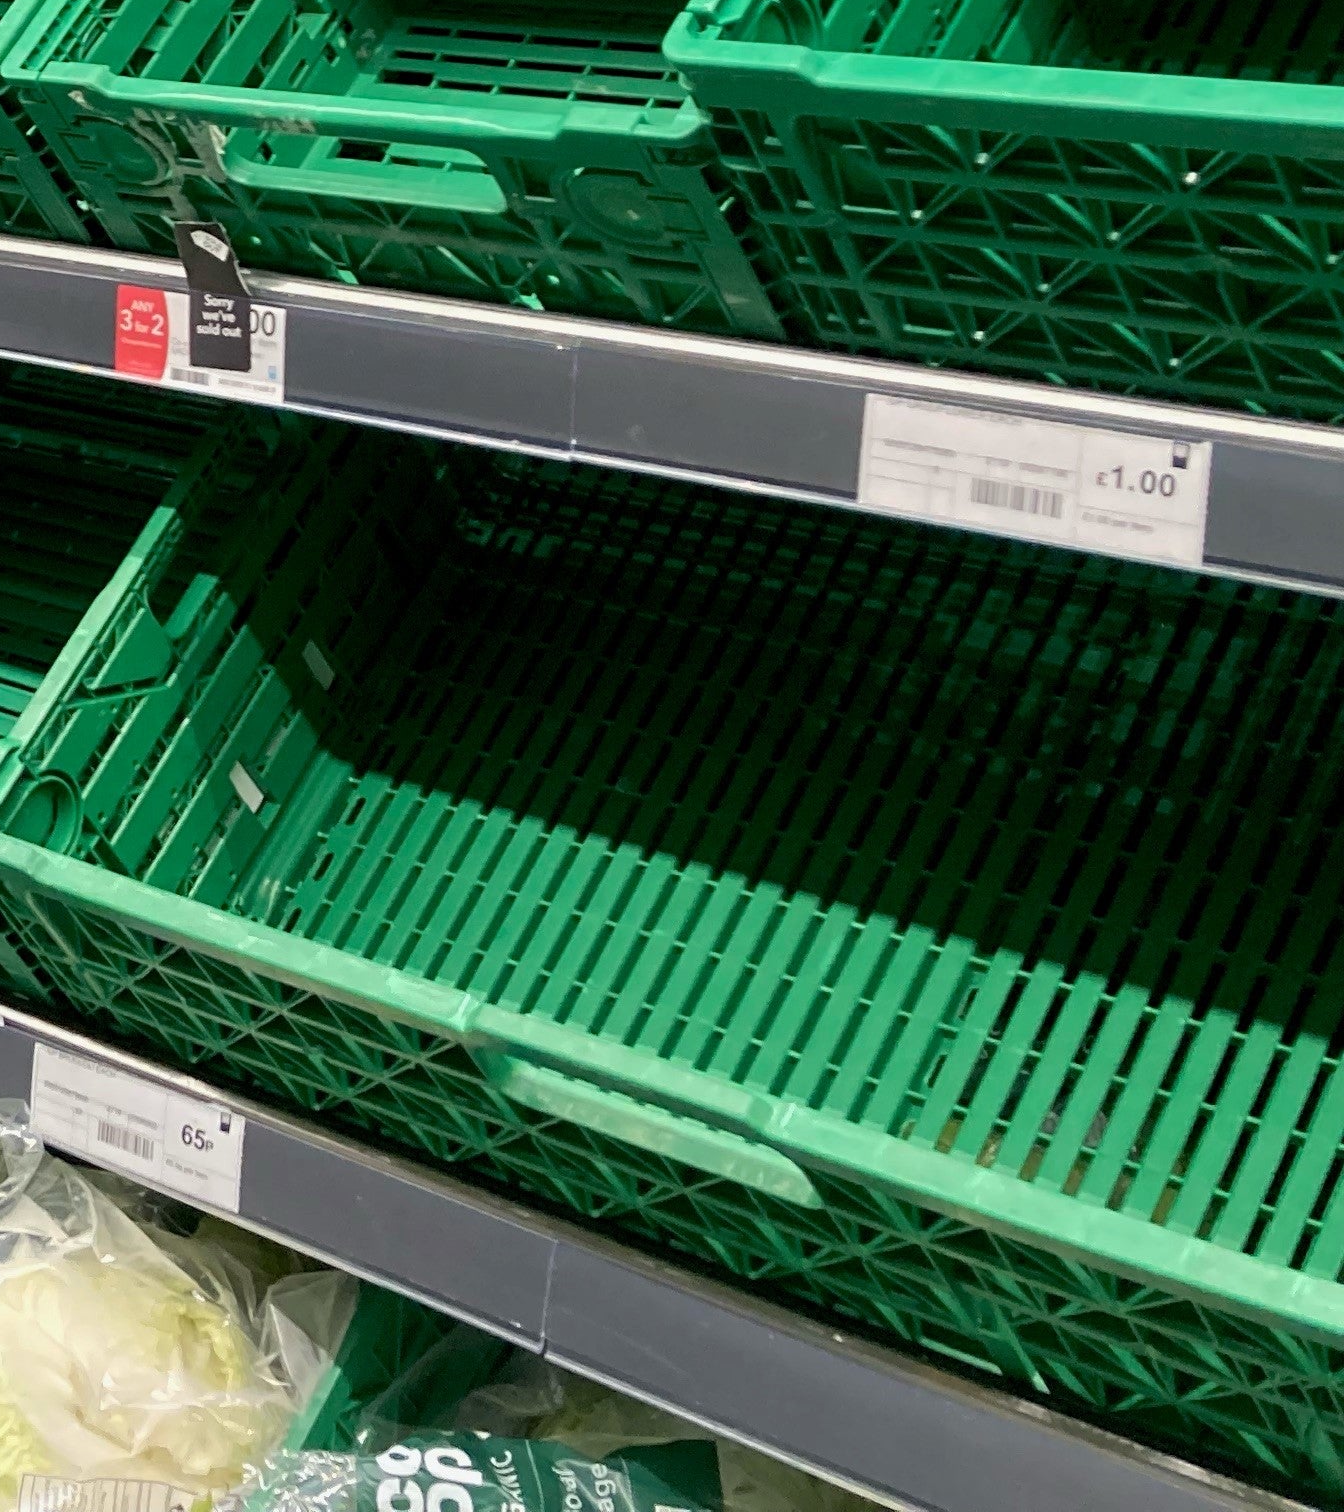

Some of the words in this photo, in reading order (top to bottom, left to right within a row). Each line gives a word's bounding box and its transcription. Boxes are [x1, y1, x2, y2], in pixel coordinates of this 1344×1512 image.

[203, 293, 235, 312] Sorry
[119, 308, 133, 332] 3
[150, 313, 165, 337] 2
[196, 322, 221, 337] sold
[1095, 465, 1176, 497] £1.00
